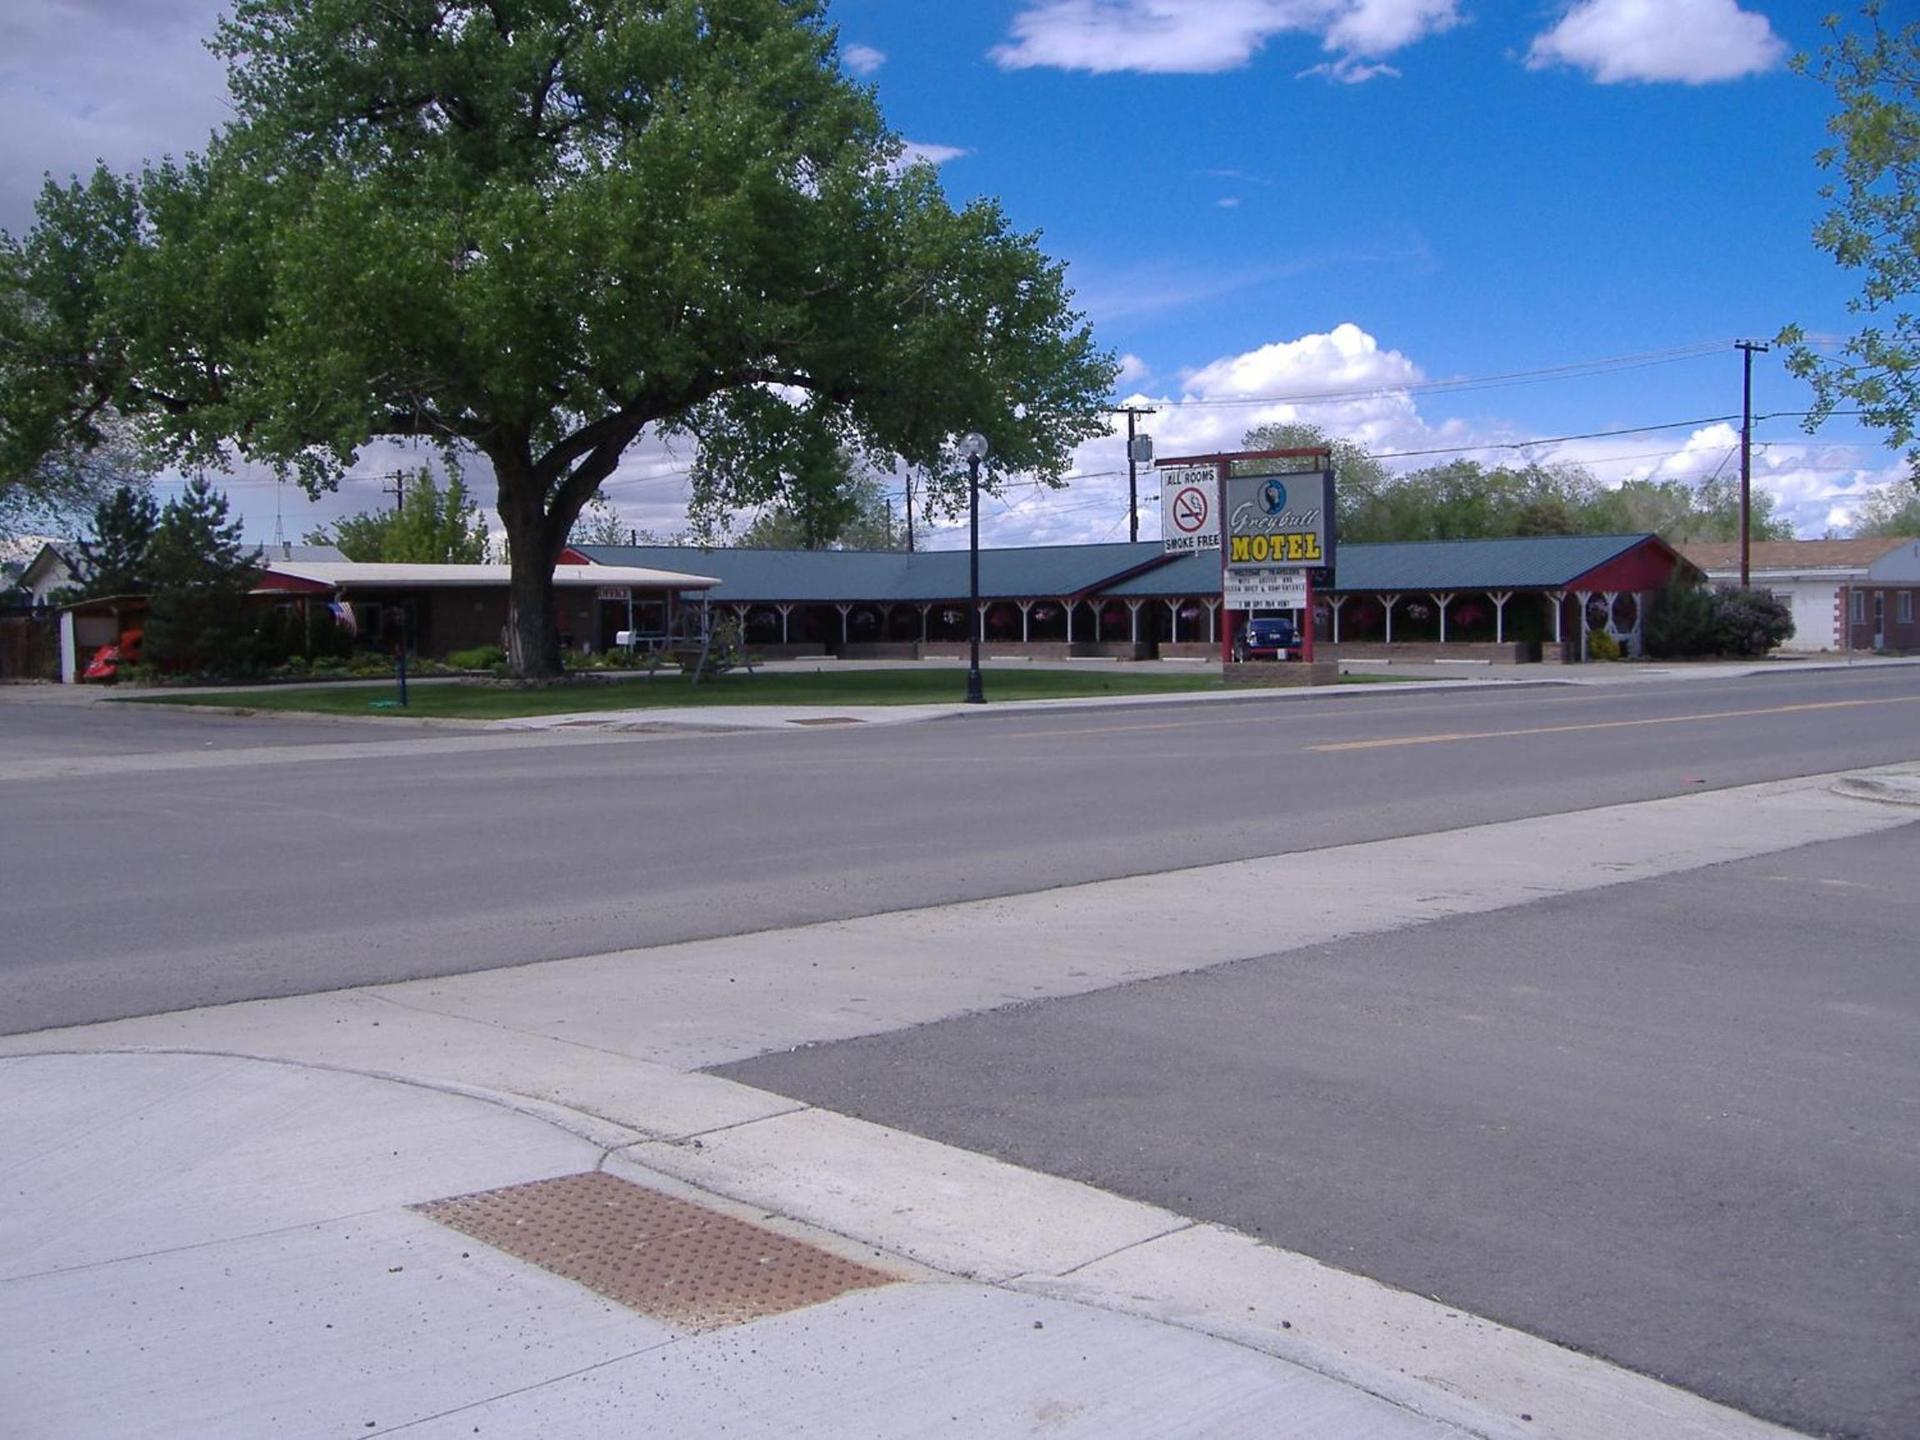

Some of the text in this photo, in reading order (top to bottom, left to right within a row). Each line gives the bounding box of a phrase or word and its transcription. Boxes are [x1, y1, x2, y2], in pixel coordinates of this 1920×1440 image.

[1167, 470, 1215, 486] ALL ROOMS
[1231, 502, 1320, 534] Greybull
[1166, 534, 1220, 550] SMOKE FREE
[1231, 533, 1321, 561] MOTEL
